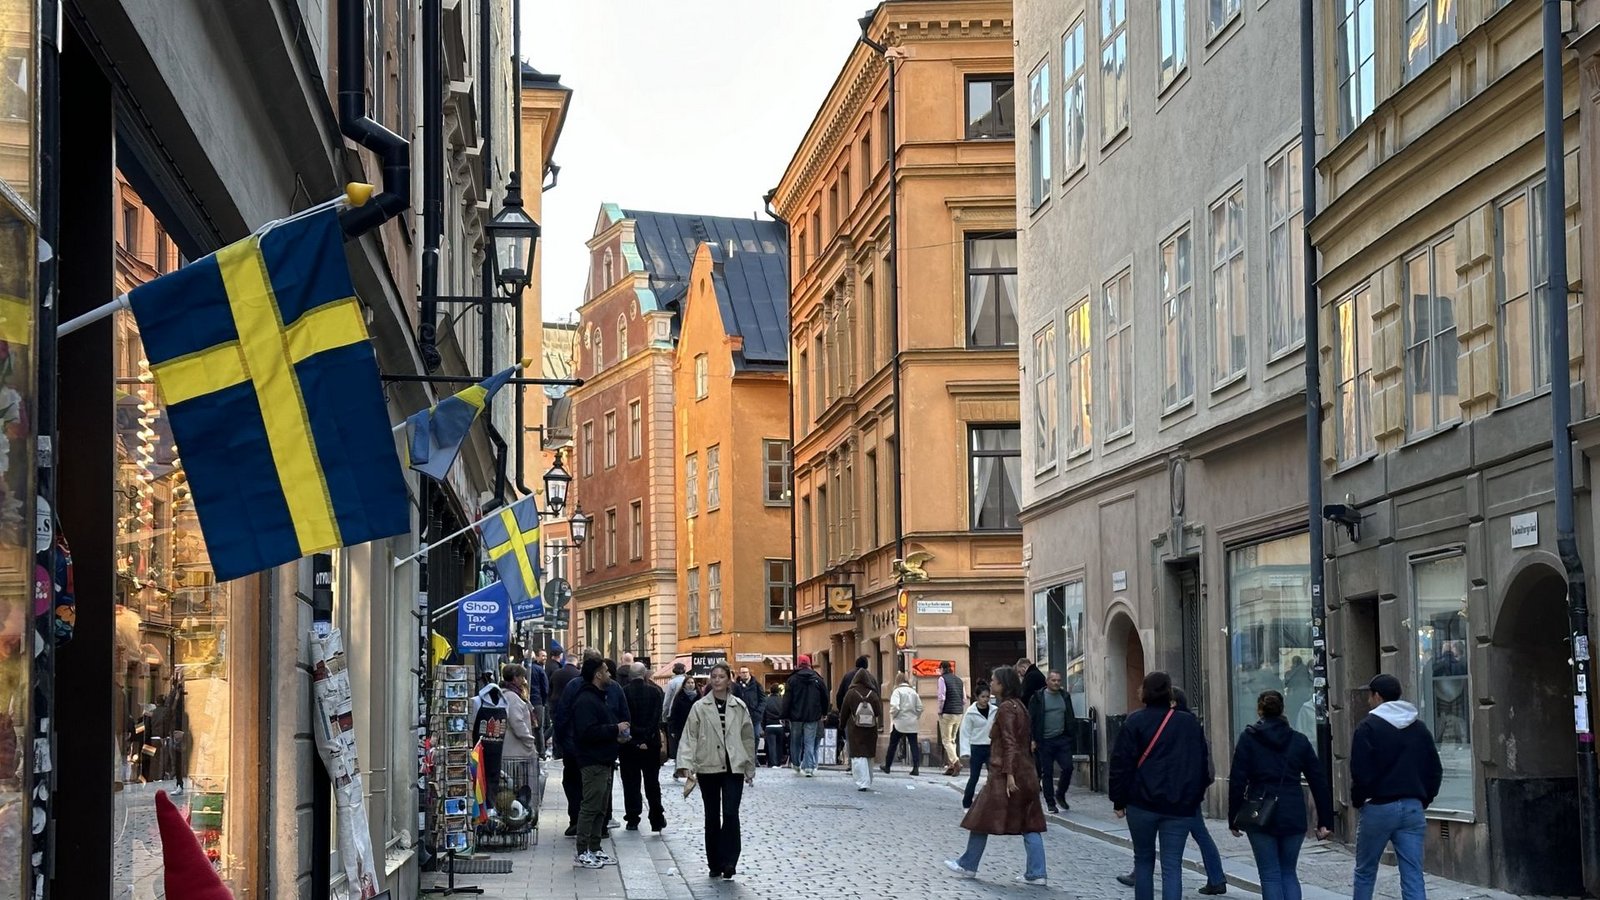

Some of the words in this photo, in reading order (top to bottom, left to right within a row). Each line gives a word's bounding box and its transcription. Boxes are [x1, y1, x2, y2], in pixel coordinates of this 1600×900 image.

[466, 602, 496, 612] Shop
[467, 614, 486, 622] Tax
[468, 624, 494, 632] Free
[693, 656, 706, 665] CAFÉ
